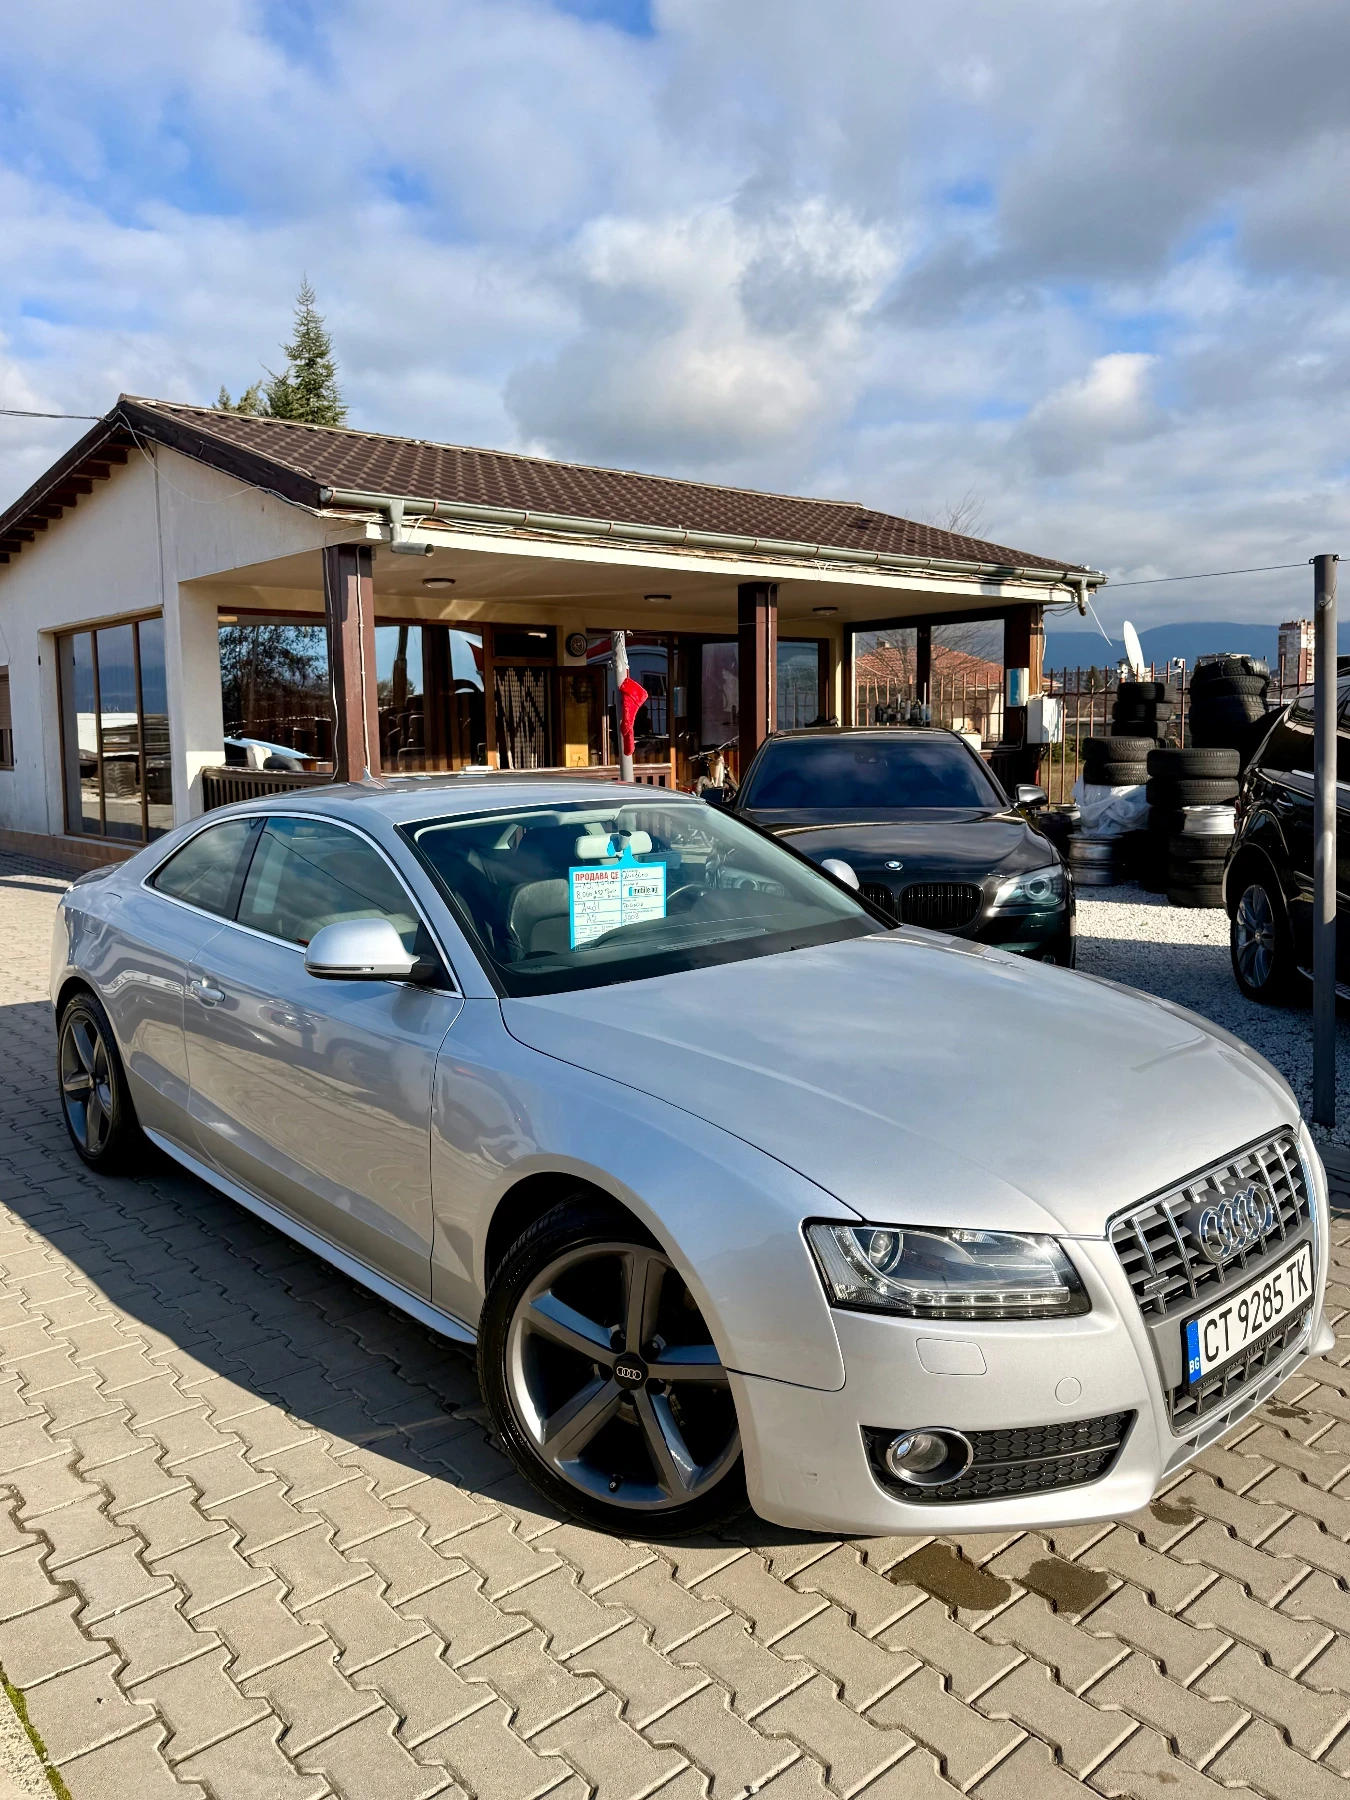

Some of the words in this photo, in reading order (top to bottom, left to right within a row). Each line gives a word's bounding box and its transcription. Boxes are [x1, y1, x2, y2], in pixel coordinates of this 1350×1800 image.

[575, 872, 609, 881] ПРОДАВА
[610, 871, 619, 880] СЕ
[1203, 1306, 1233, 1363] CT
[1237, 1273, 1284, 1341] 9285
[1286, 1253, 1309, 1304] TK
[1189, 1357, 1200, 1374] BG
